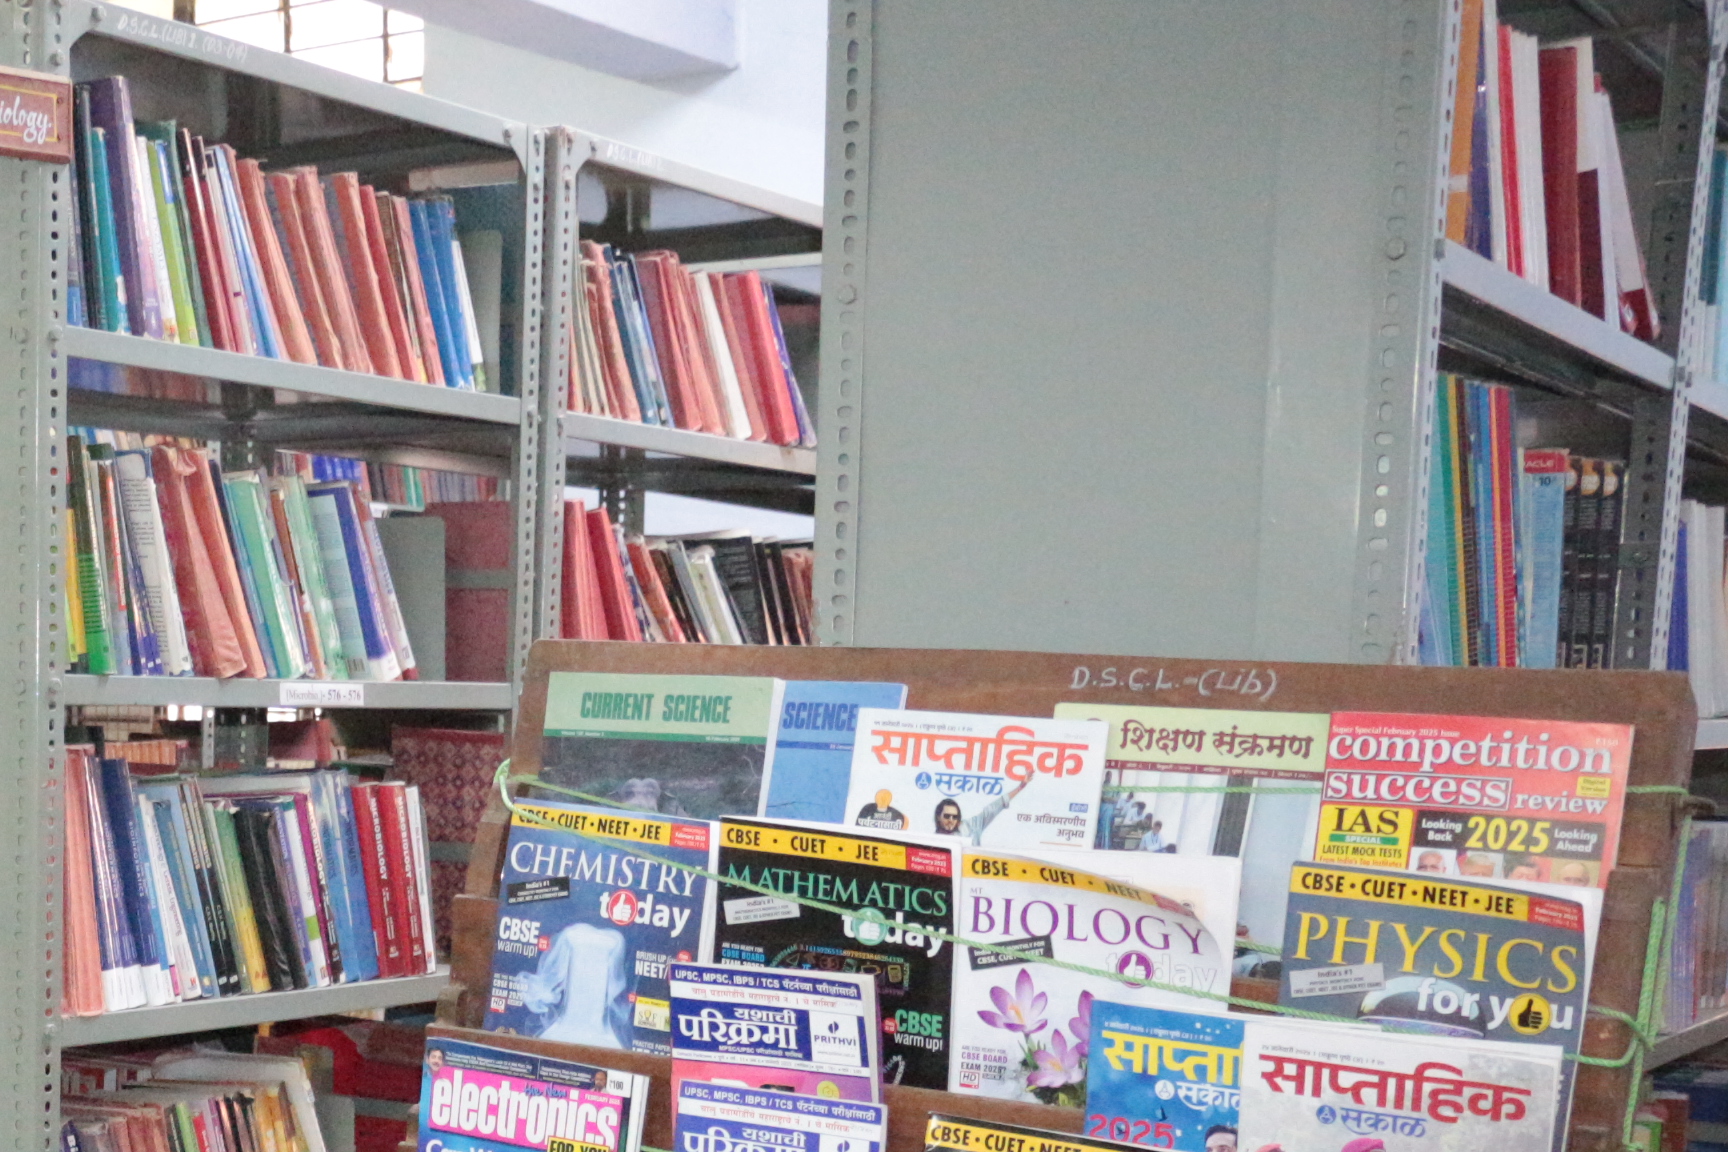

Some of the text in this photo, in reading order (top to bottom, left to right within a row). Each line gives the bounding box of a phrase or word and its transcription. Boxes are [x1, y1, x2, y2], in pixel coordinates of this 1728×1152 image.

[580, 691, 733, 724] CURRENT SCIENCE
[782, 701, 859, 732] SCIENCE
[1120, 719, 1315, 760] शिक्षण संक्रमण
[1383, 727, 1417, 737] February
[870, 725, 1090, 781] साप्ताहिक
[1328, 730, 1613, 775] competition
[935, 772, 1005, 797] सकाळ
[1327, 772, 1608, 815] success review
[1016, 813, 1032, 824] एक
[1056, 828, 1085, 842] अनुभव
[1332, 806, 1400, 836] IAS
[1422, 818, 1463, 833] Looking
[1465, 816, 1552, 854] 2025
[371, 797, 387, 880] MICROBIOLOGY
[397, 796, 412, 878] MICROBIOLOGY
[727, 827, 762, 847] CBSE
[790, 835, 827, 855] CUET
[855, 843, 880, 862] JEE
[1322, 844, 1403, 859] LATEST MOCK TESTS
[1345, 835, 1382, 845] SPECIAL
[1427, 830, 1453, 842] Back
[1554, 828, 1598, 845] Looking
[1556, 840, 1593, 853] Ahead
[510, 840, 702, 897] CHEMISTRY
[972, 858, 1142, 901] CBSE CUET NEET
[724, 862, 948, 917] MATHEMATICS
[1300, 870, 1515, 915] CBSE CUET NEET JEE
[499, 916, 541, 944] CBSE
[969, 895, 1204, 955] BIOLOGY
[1292, 909, 1578, 995] PHYSICS
[675, 969, 702, 982] UPSC,
[702, 971, 732, 986] MPSC,
[733, 974, 755, 987] IBPS
[761, 977, 780, 990] TCS
[677, 1007, 799, 1050] परिक्रमा
[894, 1008, 944, 1039] CBSE
[684, 1086, 712, 1101] UPSC,
[713, 1089, 743, 1105] MPSC,
[745, 1094, 768, 1107] IBPS
[774, 1098, 794, 1111] TCS
[1258, 1053, 1532, 1124] साप्ताहिक
[432, 1070, 619, 1152] electronics
[1340, 1106, 1428, 1139] सकाळ
[930, 1123, 971, 1147] CBSE
